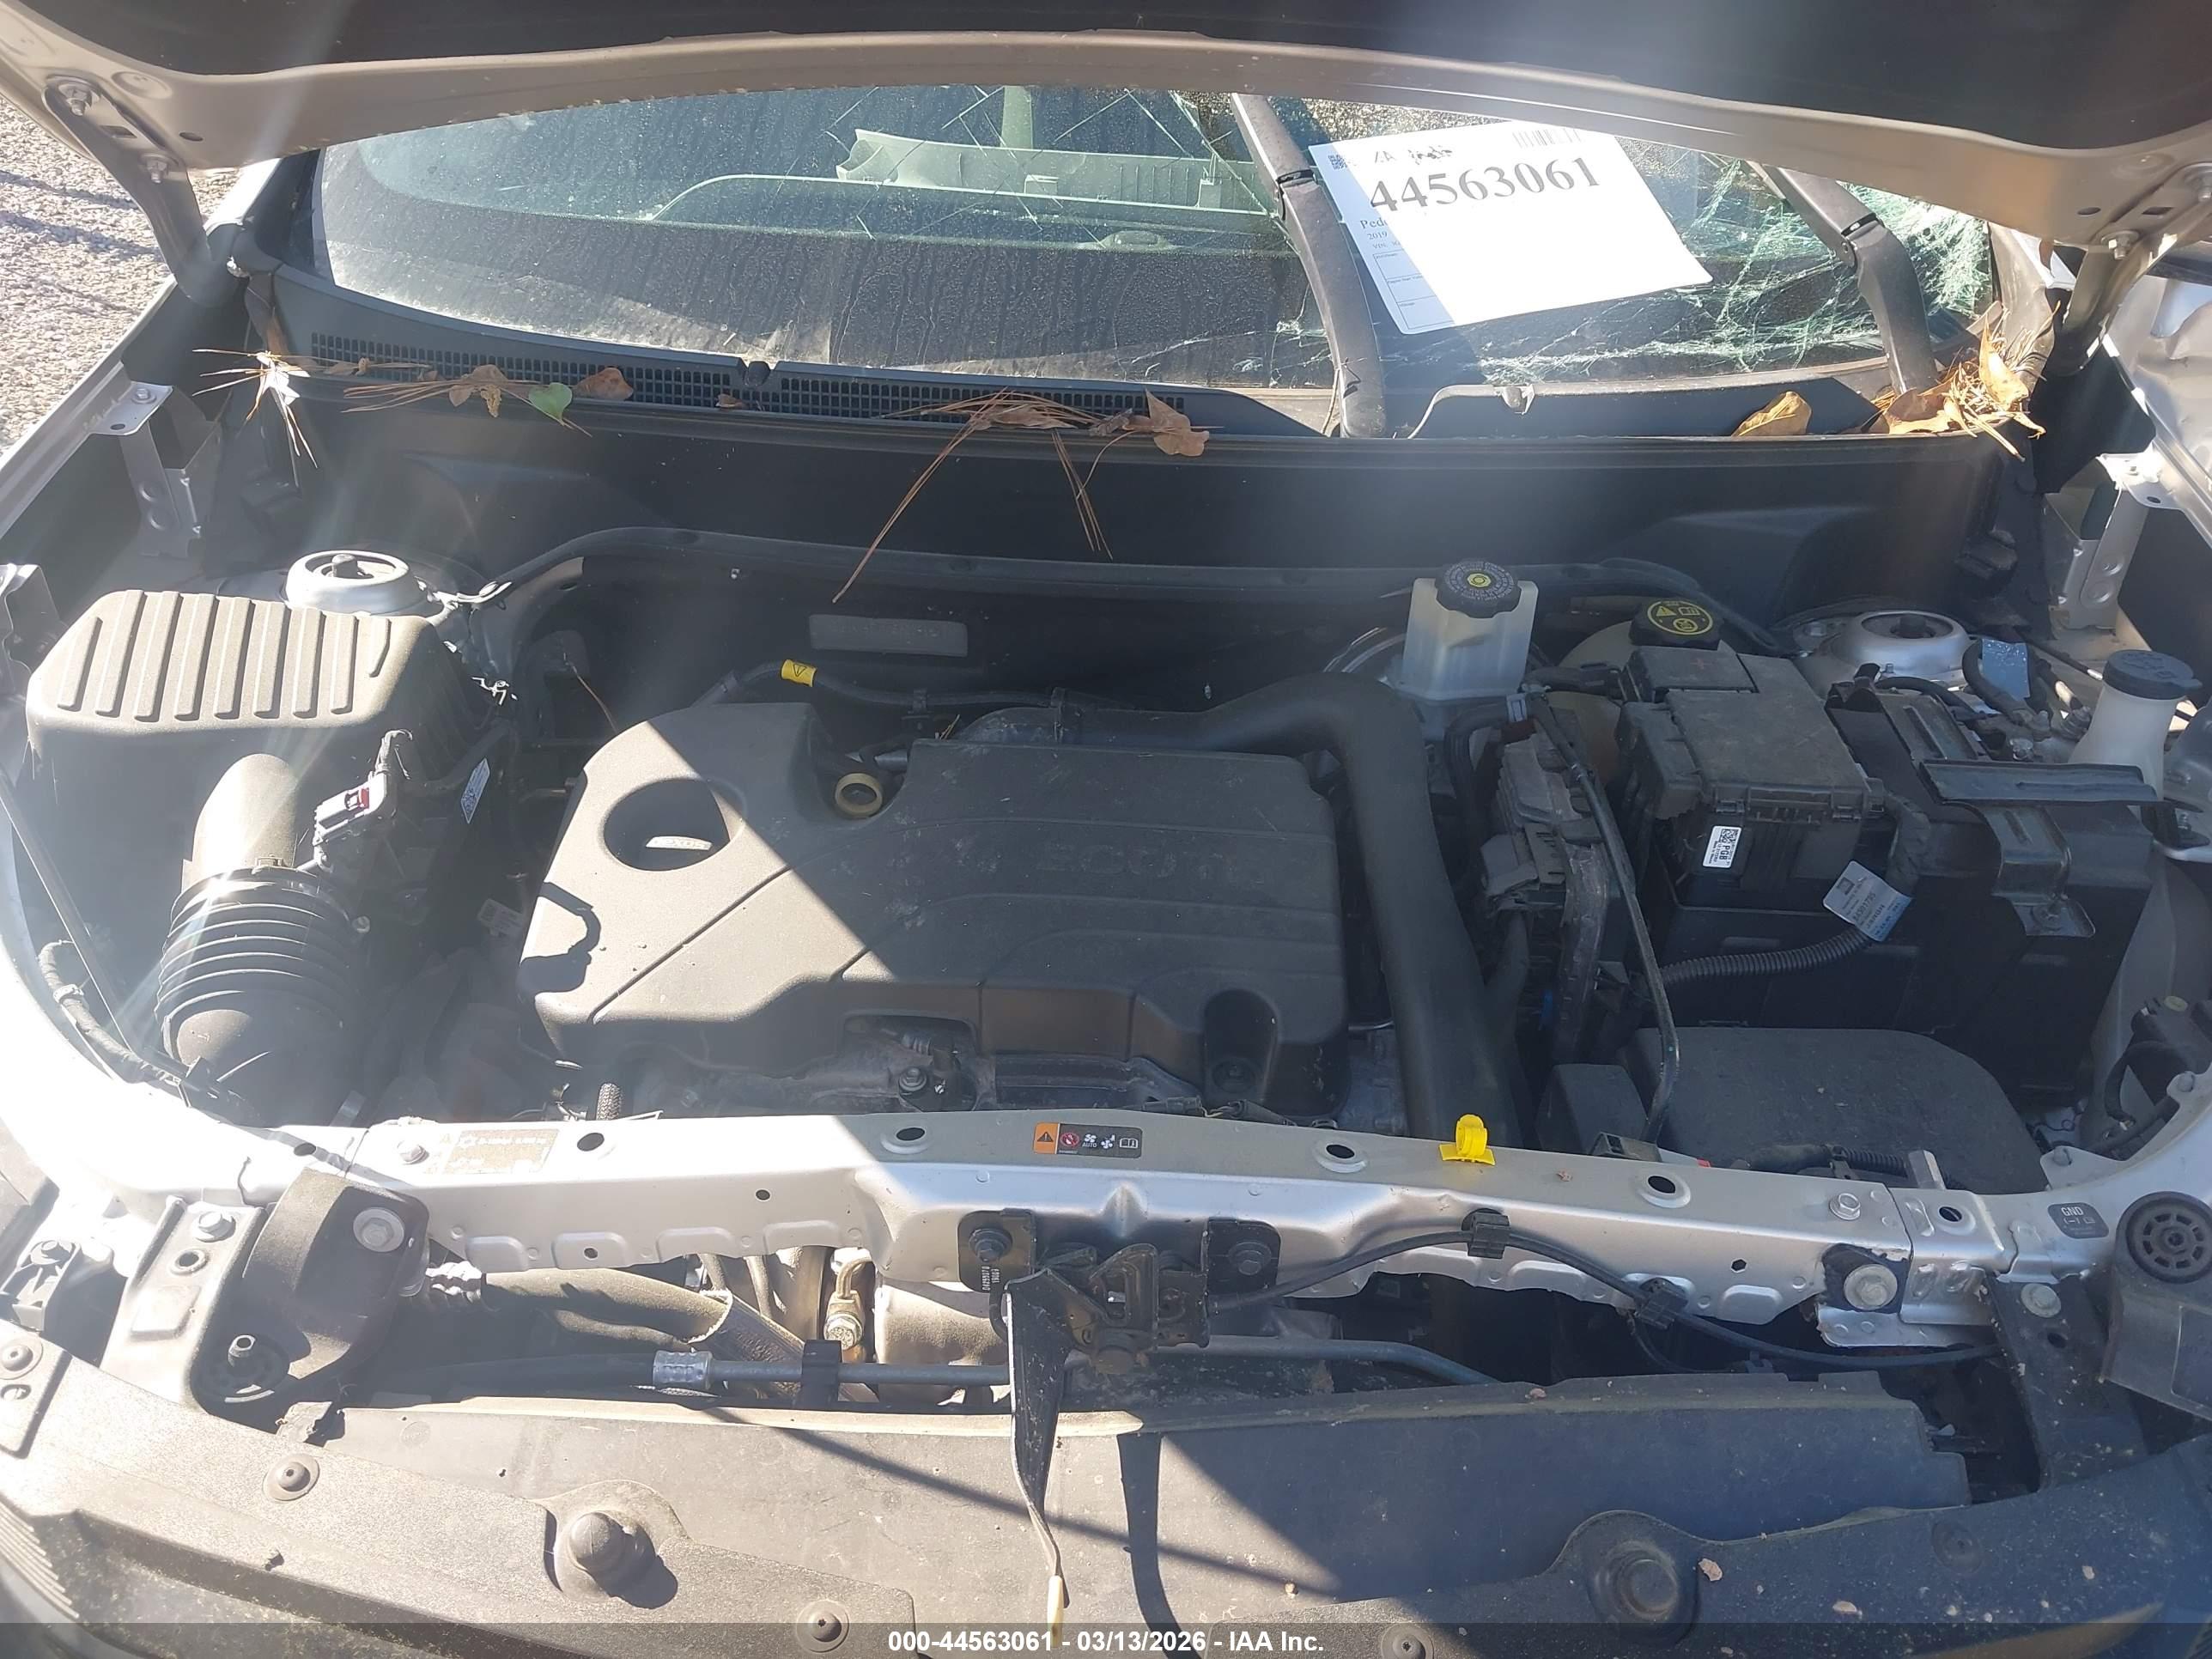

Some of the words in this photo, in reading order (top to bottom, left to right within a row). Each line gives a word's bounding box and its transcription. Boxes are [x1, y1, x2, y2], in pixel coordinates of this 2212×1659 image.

[1370, 157, 1599, 212] 44563061
[1359, 216, 1388, 230] Ped
[1366, 230, 1388, 241] 2019
[1719, 845, 1730, 860] PGB
[2061, 1206, 2084, 1217] GND
